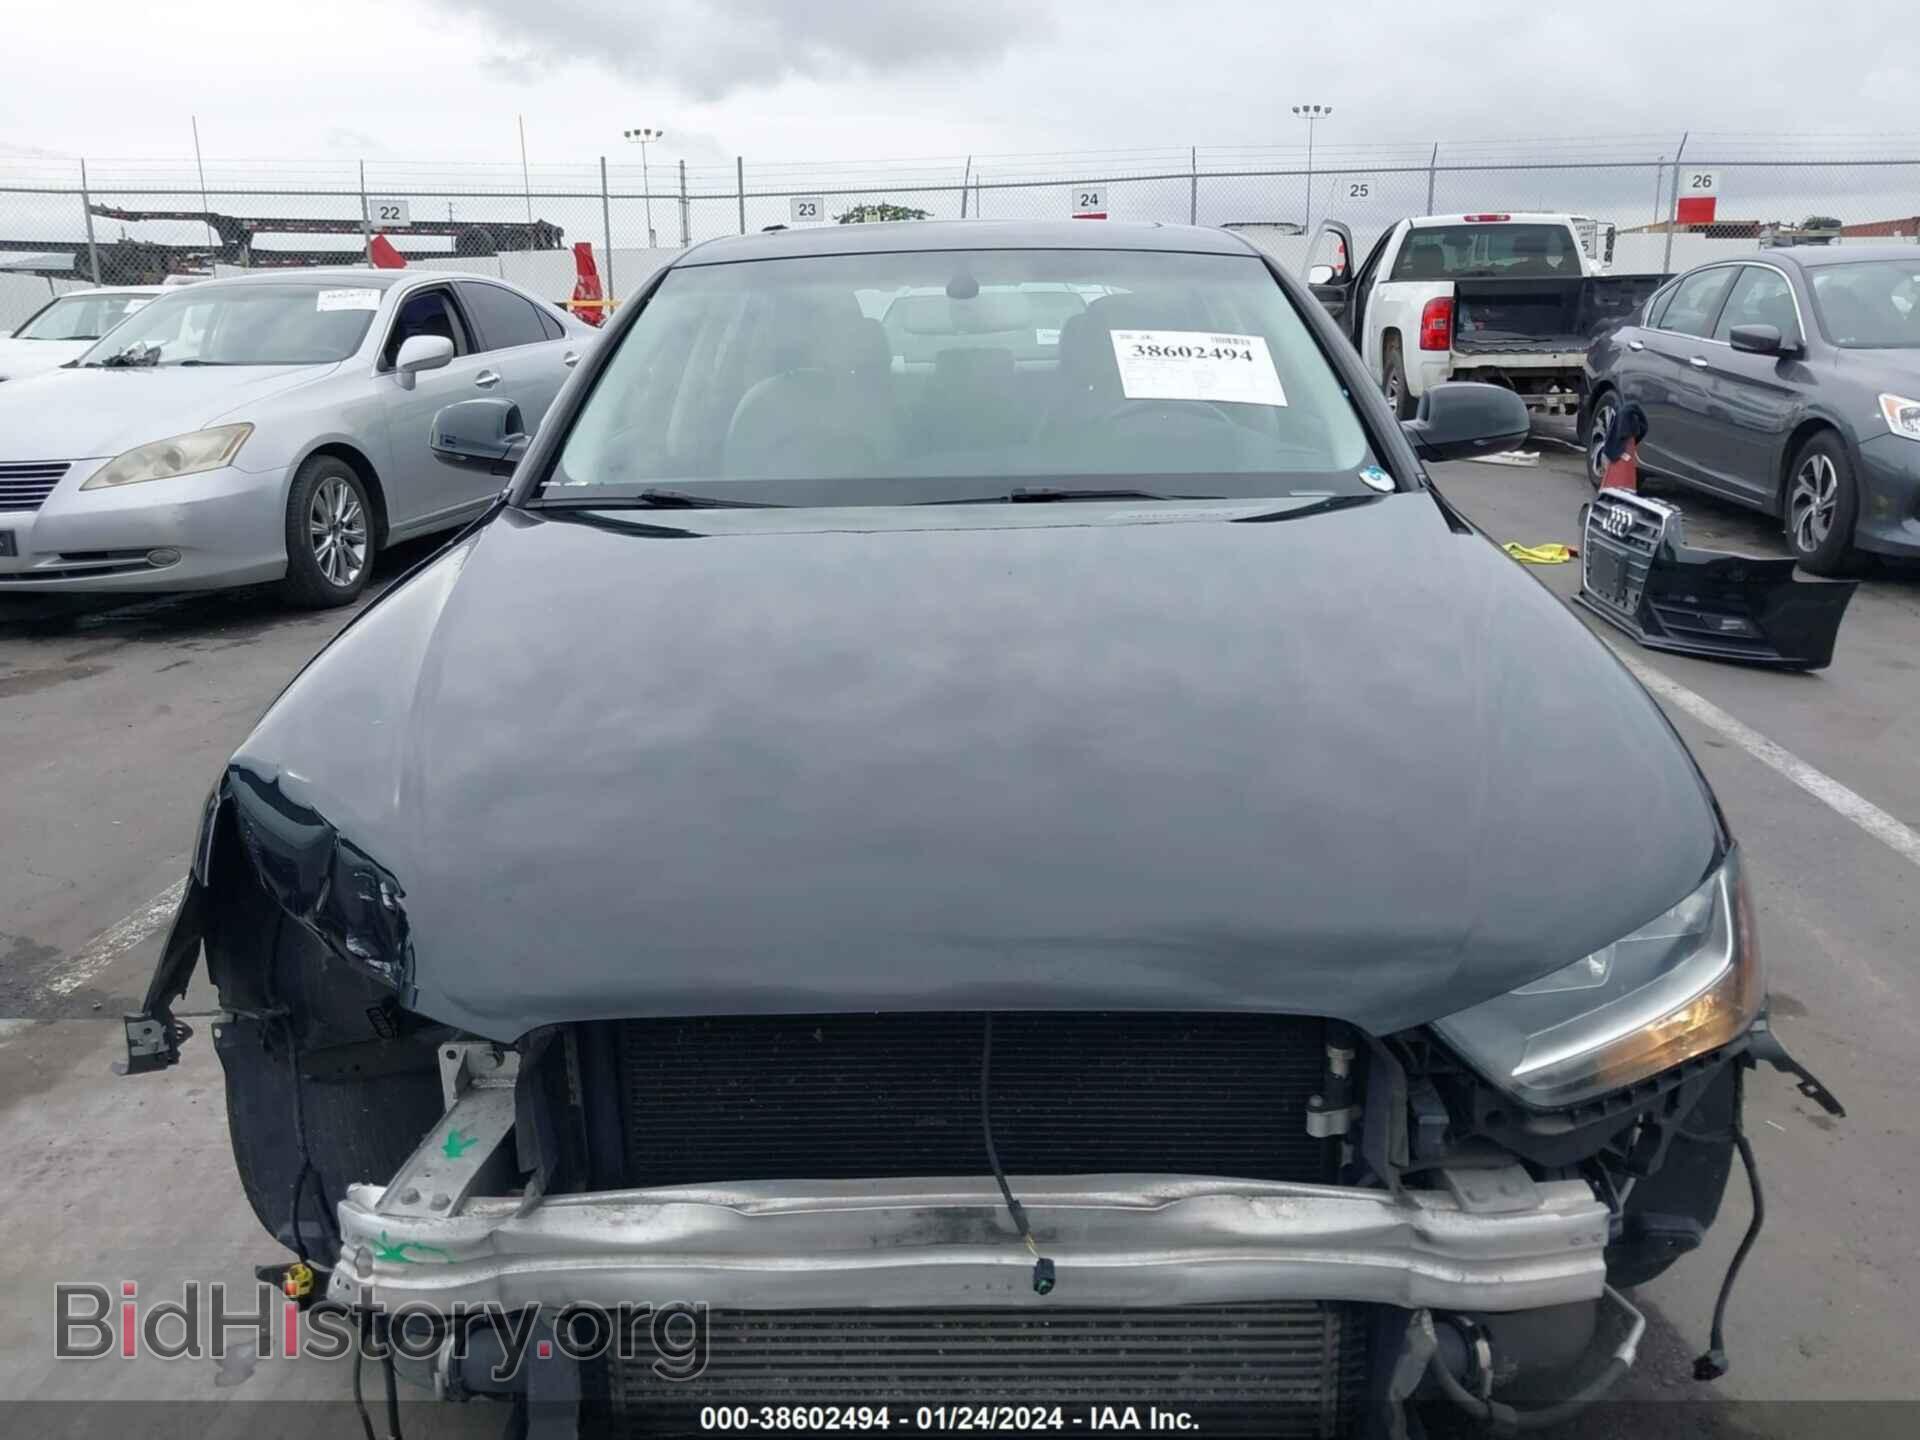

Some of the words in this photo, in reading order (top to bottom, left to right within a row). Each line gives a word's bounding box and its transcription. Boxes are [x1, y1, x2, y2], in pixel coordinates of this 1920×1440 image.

[1692, 174, 1712, 188] 26
[1350, 183, 1369, 198] 25
[1080, 193, 1098, 207] 24
[380, 206, 400, 220] 22
[799, 203, 816, 216] 23
[1132, 344, 1253, 362] 38602494
